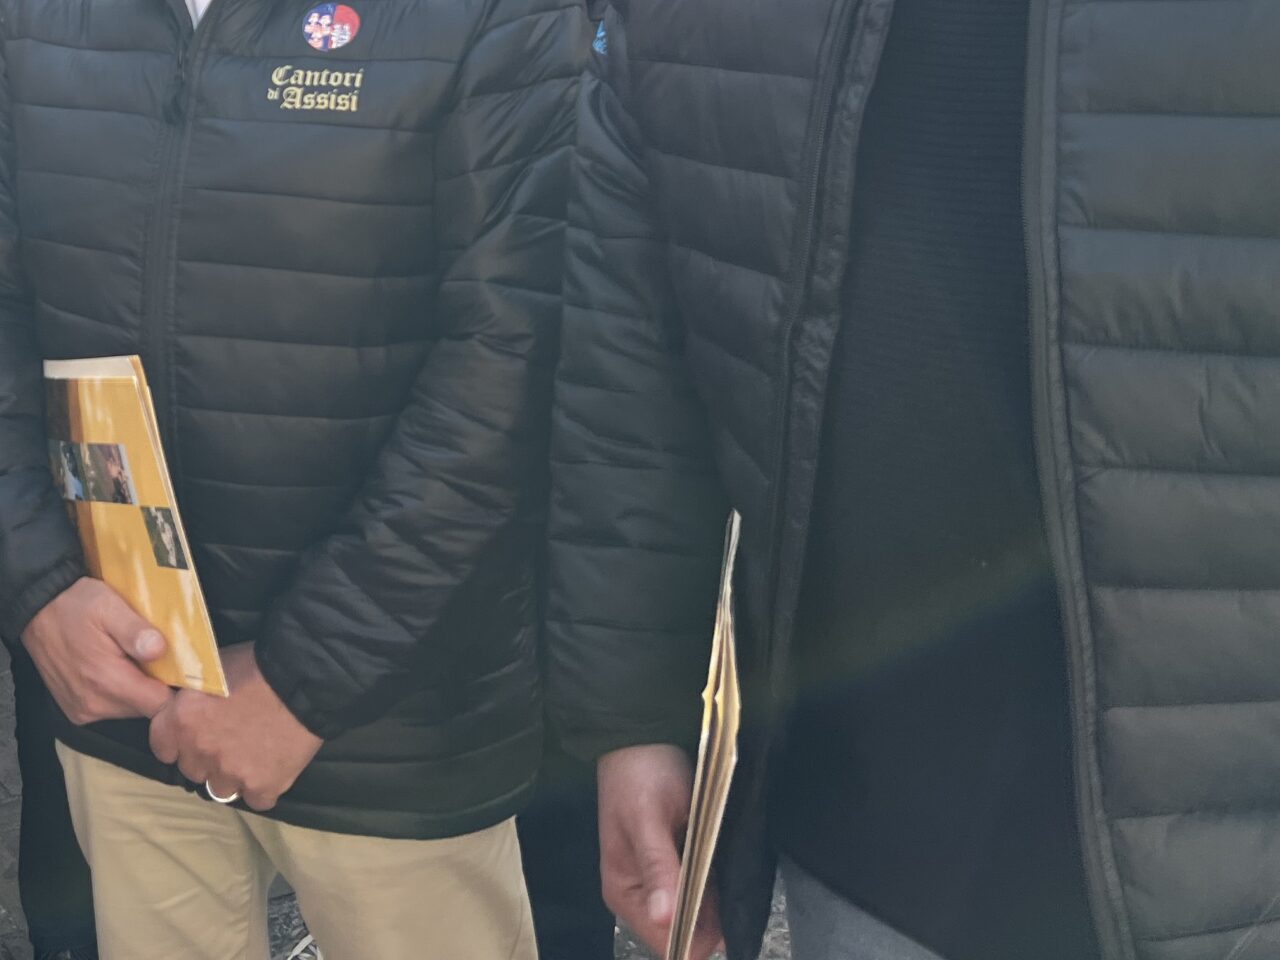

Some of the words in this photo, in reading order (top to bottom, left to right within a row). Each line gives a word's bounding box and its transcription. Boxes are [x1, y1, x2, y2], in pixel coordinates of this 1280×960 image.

[271, 65, 364, 88] Cantori
[267, 87, 280, 100] di
[280, 86, 360, 112] Assisi
